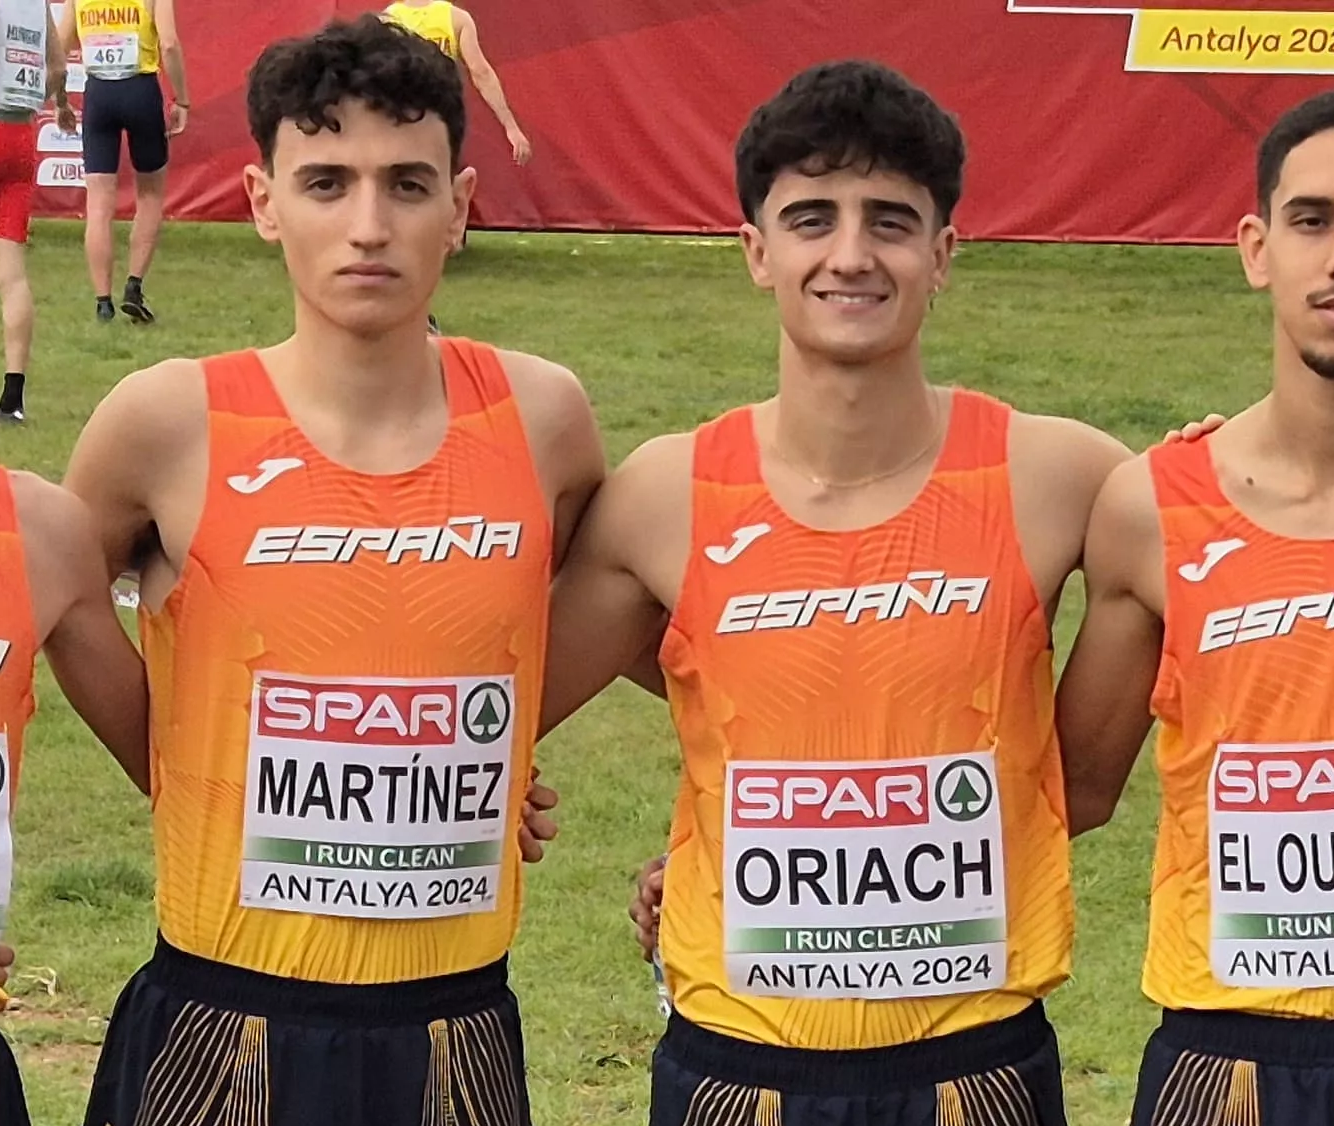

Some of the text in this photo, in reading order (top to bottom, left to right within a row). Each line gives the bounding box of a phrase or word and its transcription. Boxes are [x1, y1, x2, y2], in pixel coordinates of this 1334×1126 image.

[95, 49, 124, 64] 467
[1160, 26, 1282, 60] Antalya
[15, 68, 41, 89] 436
[243, 515, 522, 566] ESPAÑA
[715, 571, 990, 634] ESPAÑA
[265, 687, 452, 737] SPAR
[257, 753, 505, 824] MARTÍNEZ
[736, 775, 924, 820] SPAR
[305, 844, 311, 862] I
[317, 845, 375, 866] RUN
[734, 838, 992, 906] ORIACH
[1217, 832, 1265, 893] EL
[260, 872, 489, 908] ANTALYA 2024
[785, 931, 792, 949] I
[796, 930, 853, 949] RUN
[1267, 917, 1274, 935] I
[1277, 915, 1333, 935] RUN
[746, 953, 992, 988] ANTALYA 2024
